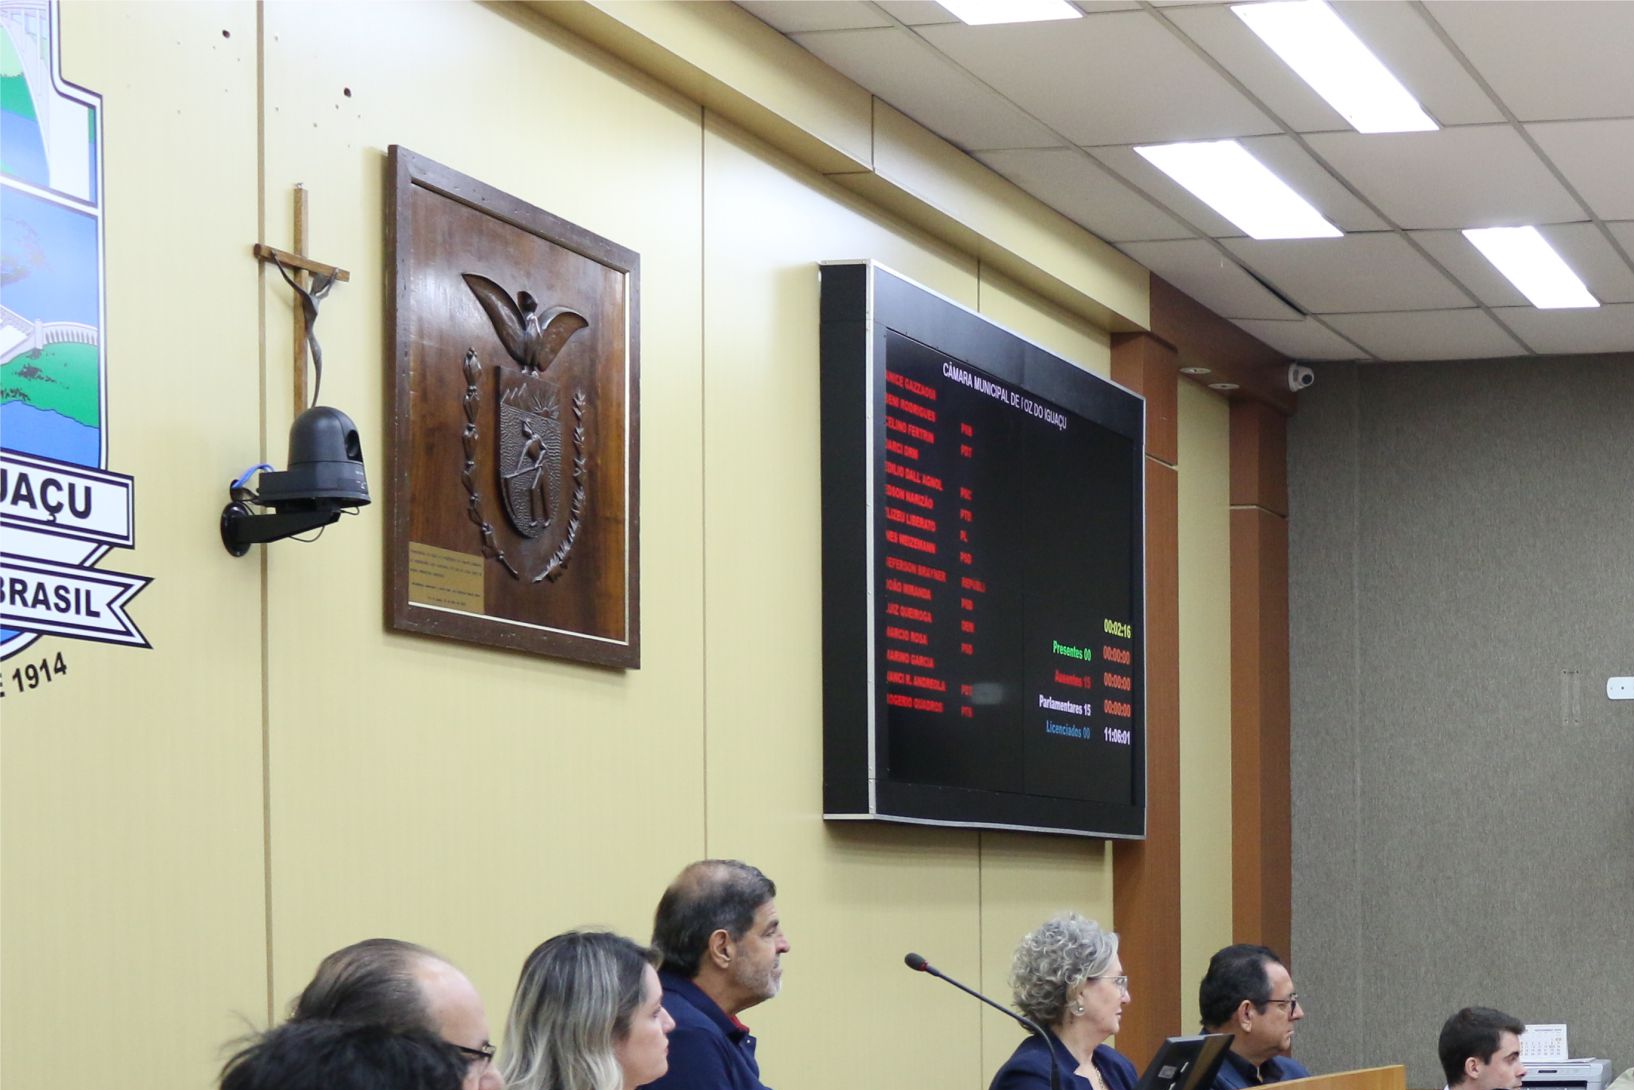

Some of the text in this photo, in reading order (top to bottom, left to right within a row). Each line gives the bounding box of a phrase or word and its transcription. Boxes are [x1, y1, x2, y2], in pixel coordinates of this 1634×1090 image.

[942, 361, 973, 388] CÂMARA
[973, 375, 1009, 404] MUNICIPAL
[1010, 392, 1020, 409] DE
[1033, 402, 1044, 419] DO
[1044, 407, 1067, 431] IGUAÇU
[0, 468, 92, 524] AÇU
[0, 577, 101, 618] RASIL
[1103, 618, 1132, 639] 00:02:16
[1052, 640, 1092, 662] Presentes 00
[12, 651, 67, 693] 1914
[1039, 694, 1092, 717] Parlamentares 15
[1046, 720, 1082, 738] Licenciados
[1103, 726, 1131, 745] 11:06:01
